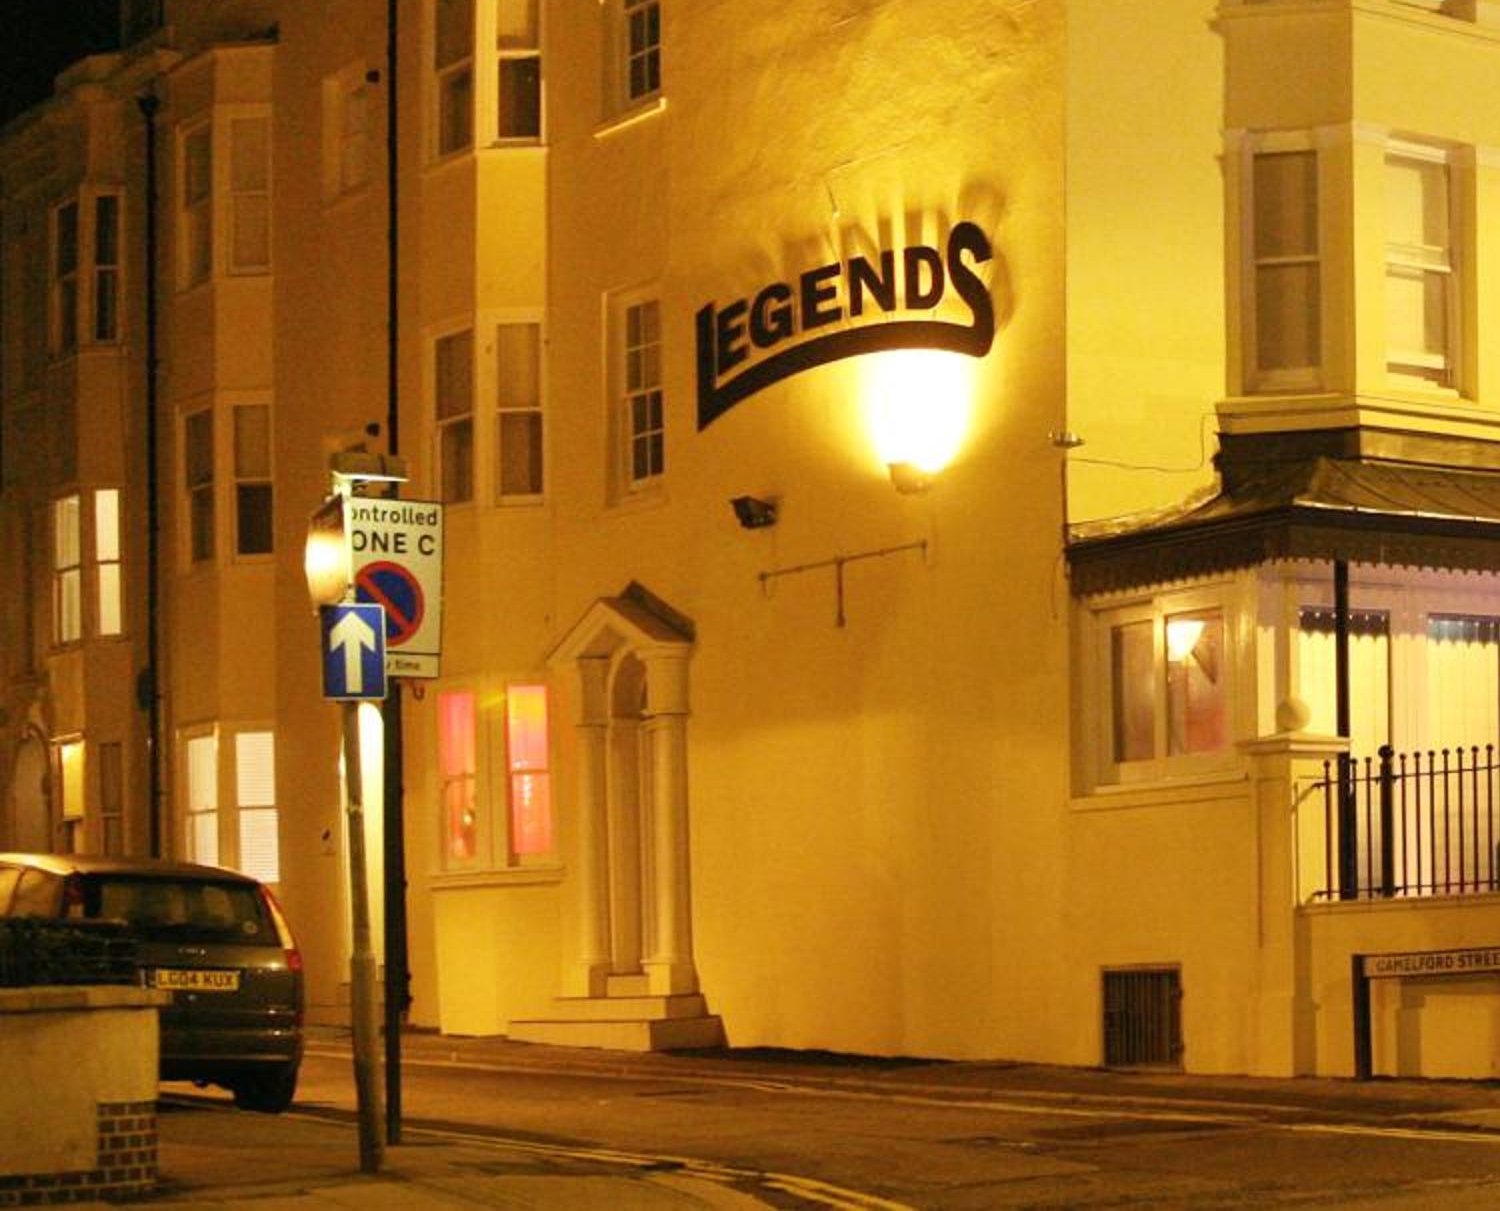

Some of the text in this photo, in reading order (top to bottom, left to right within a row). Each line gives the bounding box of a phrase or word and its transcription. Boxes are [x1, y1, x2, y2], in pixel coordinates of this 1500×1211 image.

[696, 221, 994, 432] LEGENDS
[352, 504, 437, 526] ontrolled
[352, 530, 434, 556] ONE C
[1375, 955, 1455, 973] CAMELFORD
